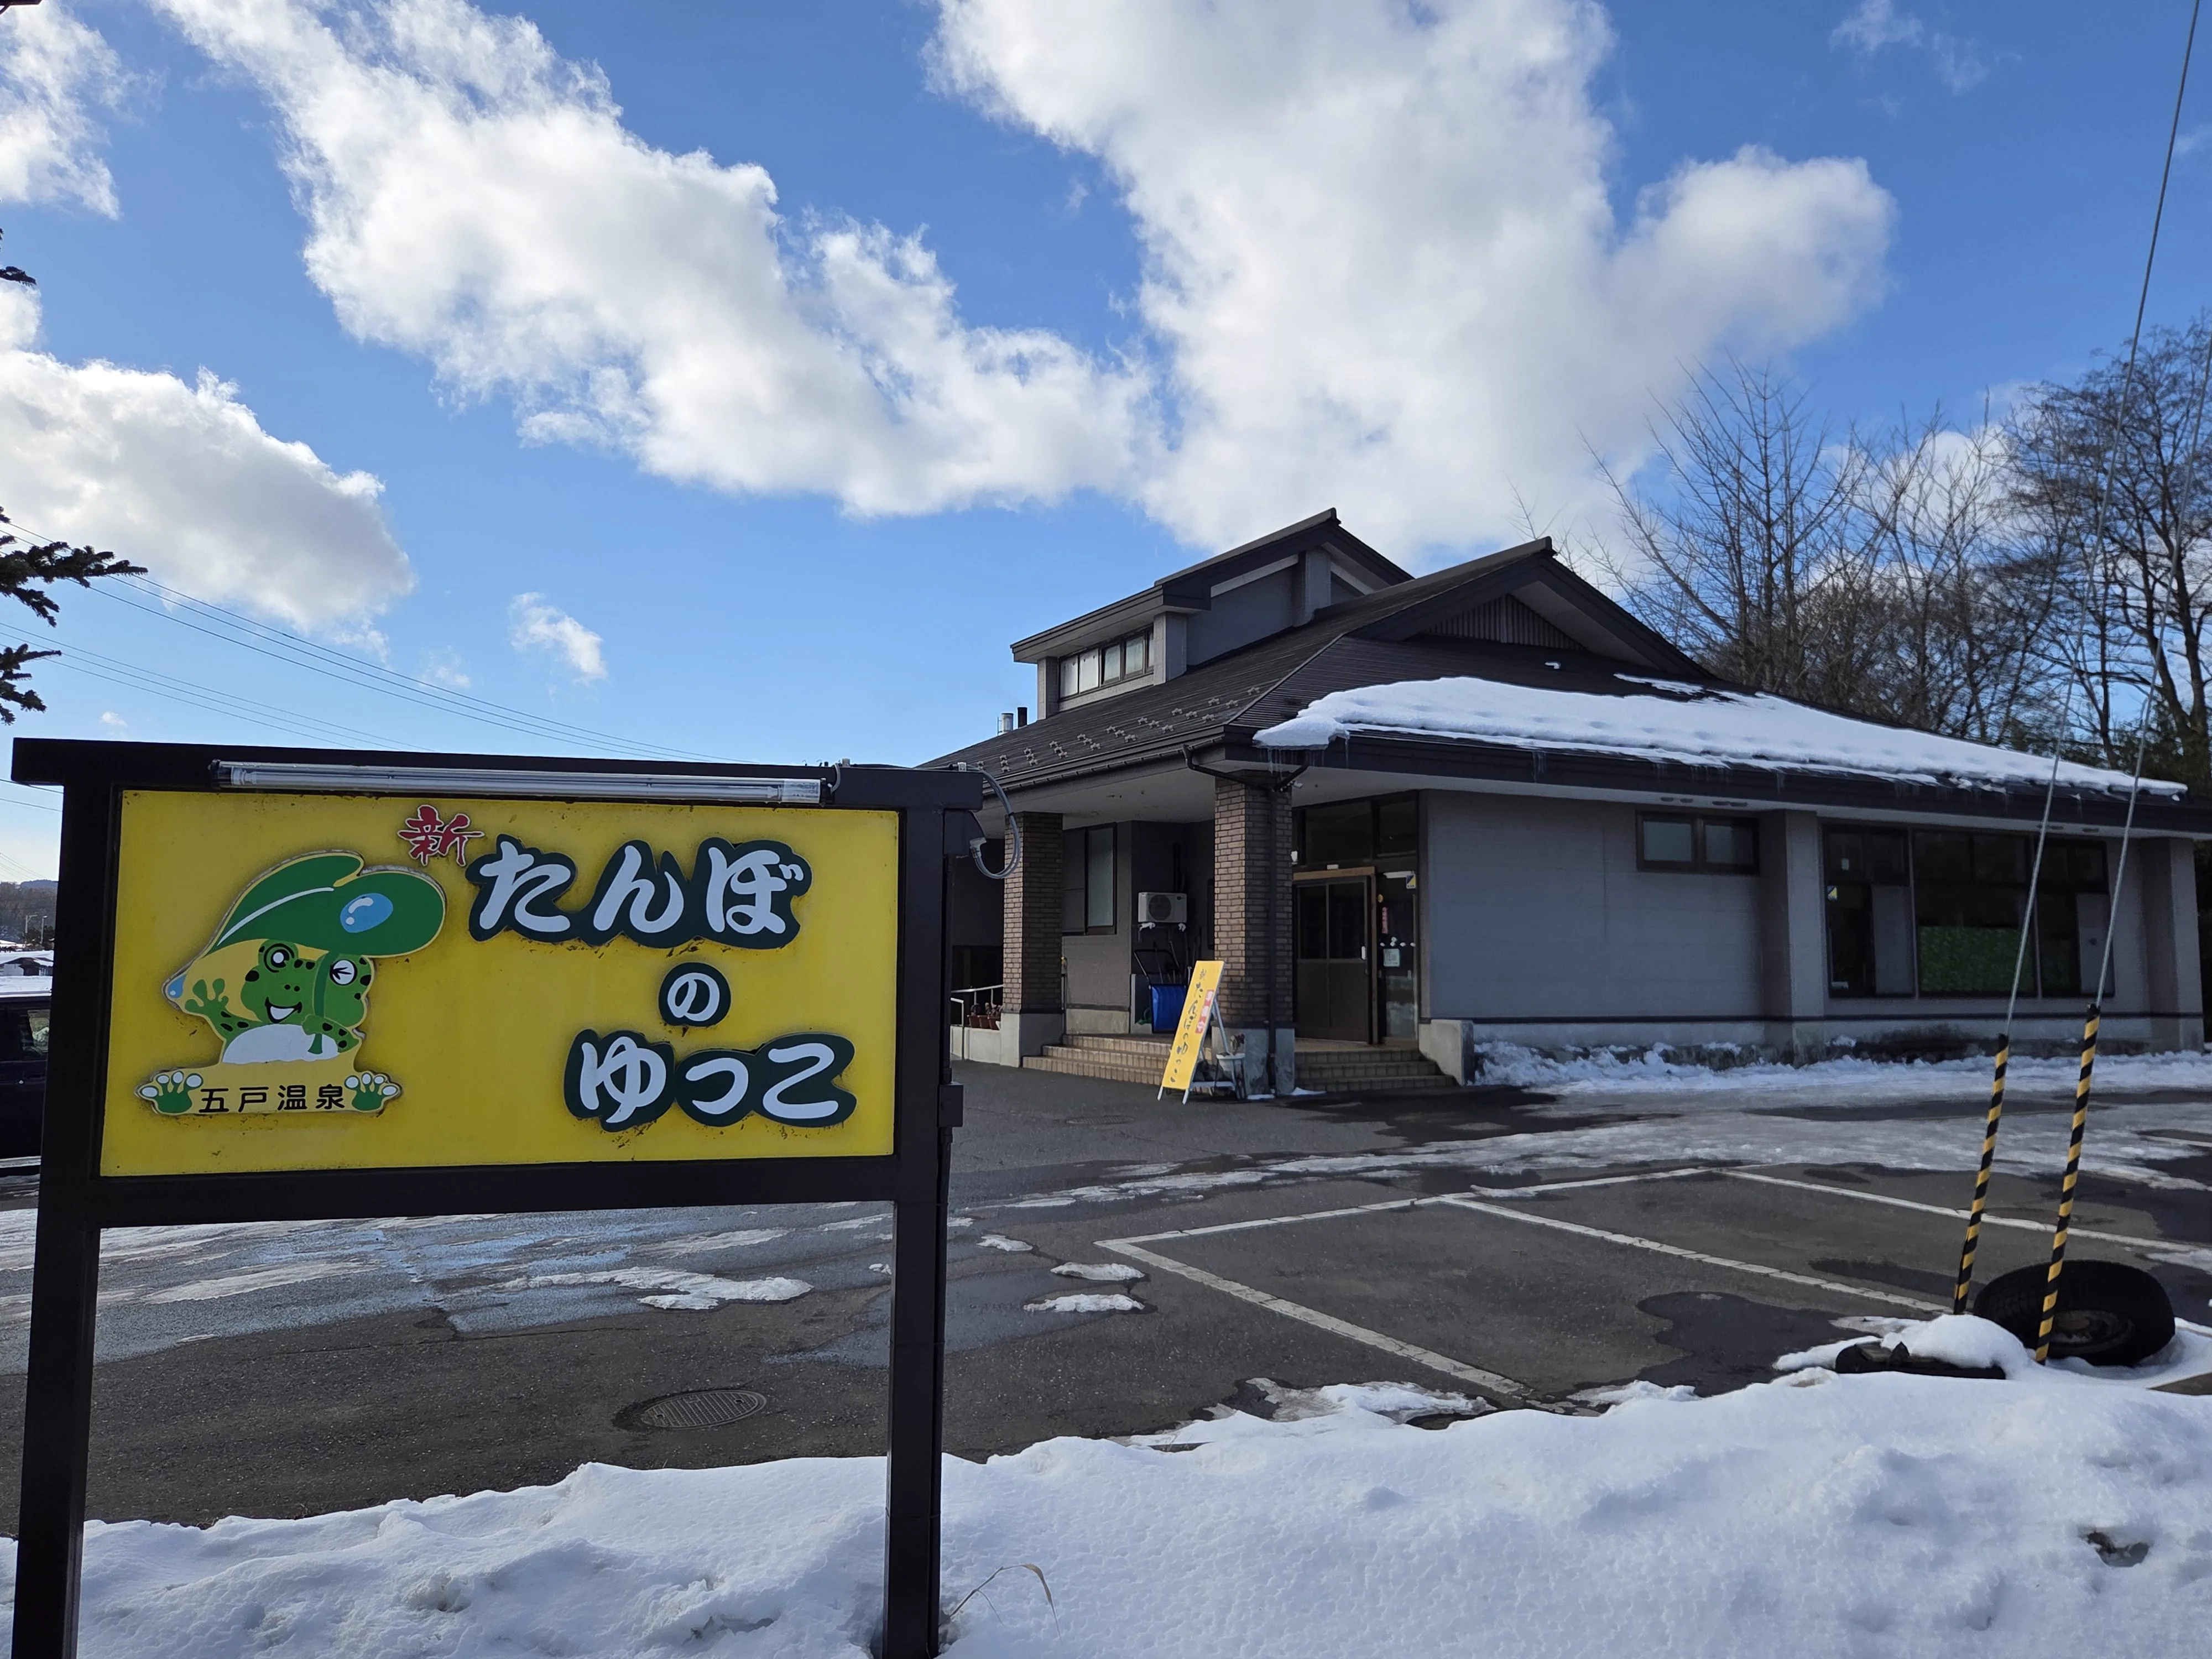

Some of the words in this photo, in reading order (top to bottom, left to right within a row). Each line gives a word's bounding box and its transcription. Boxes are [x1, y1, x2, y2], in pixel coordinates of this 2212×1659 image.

[398, 804, 484, 867] 新
[478, 840, 806, 935] たんぼ
[665, 971, 722, 1023] の
[198, 1084, 346, 1113] 五戸温泉
[578, 1035, 840, 1124] ゆっこ
